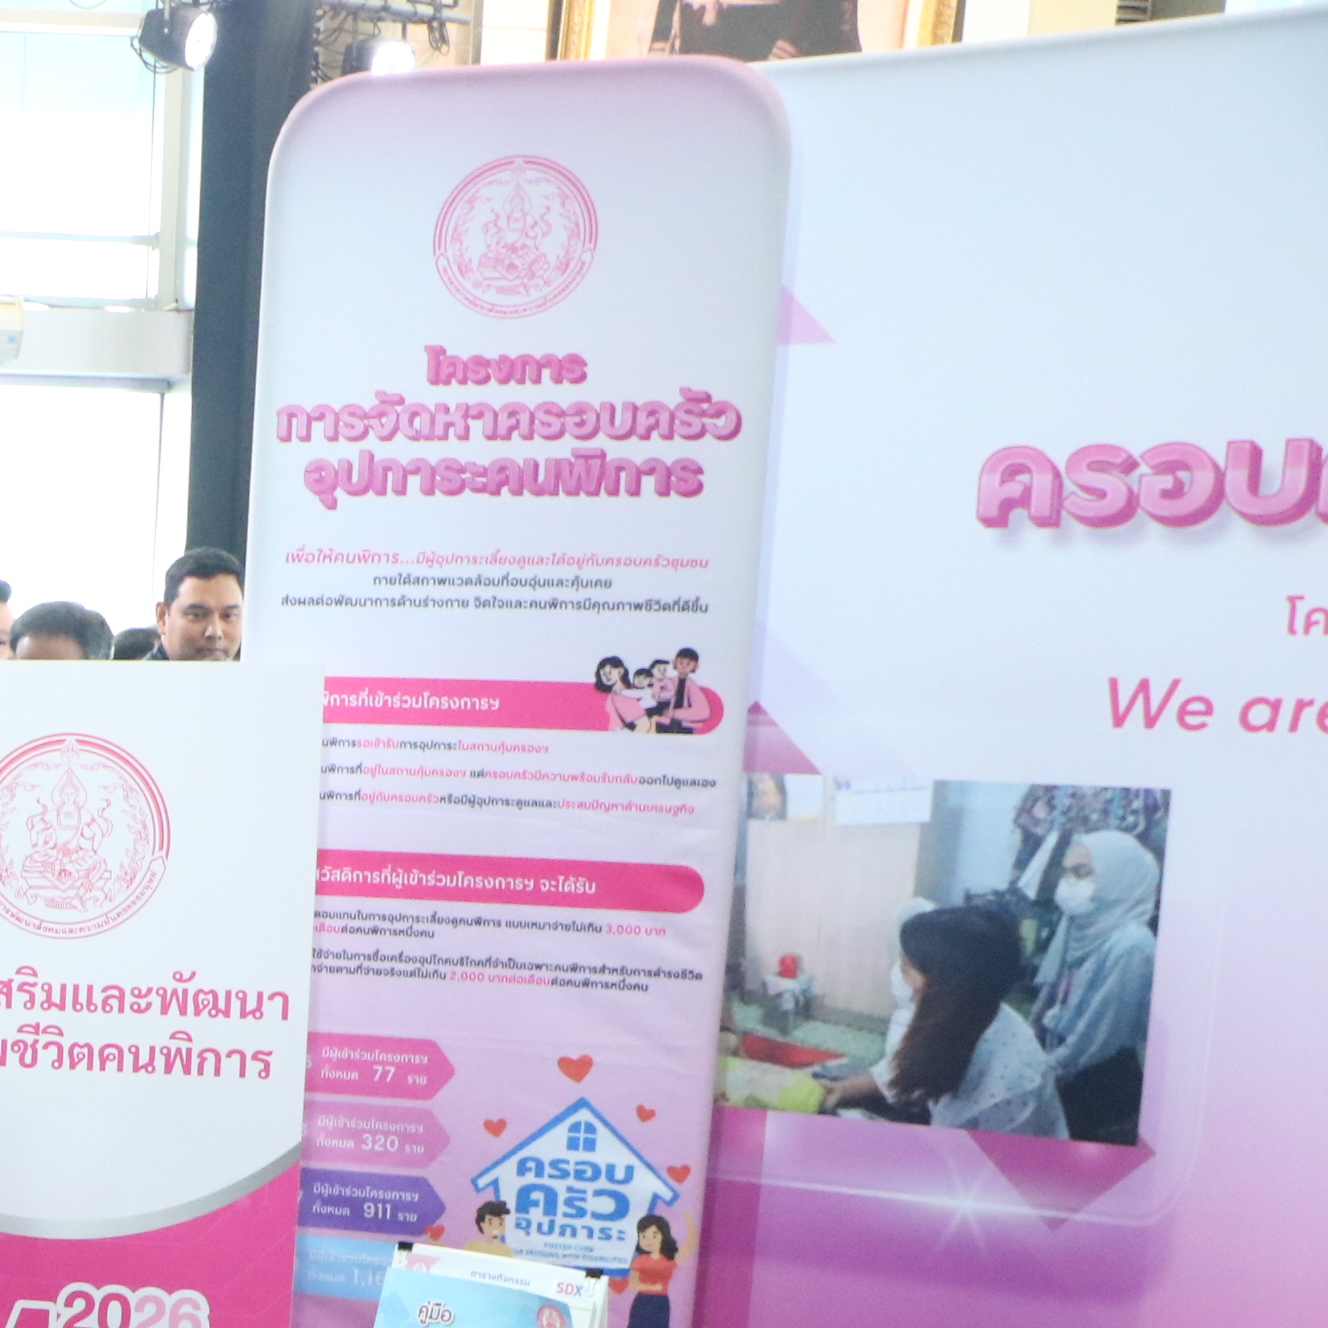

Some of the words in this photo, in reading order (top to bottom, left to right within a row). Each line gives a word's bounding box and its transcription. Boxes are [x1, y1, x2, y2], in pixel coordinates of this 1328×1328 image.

[424, 345, 587, 385] โครงการ
[276, 387, 742, 441] การจัดหาครอบครัว
[304, 448, 704, 510] อุปการะคนพิการ
[976, 438, 1328, 529] ครอบ
[1108, 677, 1214, 732] We
[540, 876, 596, 894] จะได้รับ
[605, 923, 641, 936] 3,000
[449, 971, 485, 983] 2,000
[372, 1065, 396, 1083] 77
[407, 1074, 428, 1085] ราย
[361, 1134, 399, 1152] 320
[405, 1143, 425, 1154] ราย
[516, 1156, 634, 1185] ครอบ
[363, 1202, 392, 1220] 911
[397, 1212, 418, 1223] ราย
[515, 1183, 630, 1222] ครัว
[515, 1216, 625, 1241] อุปการะ
[556, 1281, 584, 1297] SDX
[418, 1301, 452, 1325] คู่มือ
